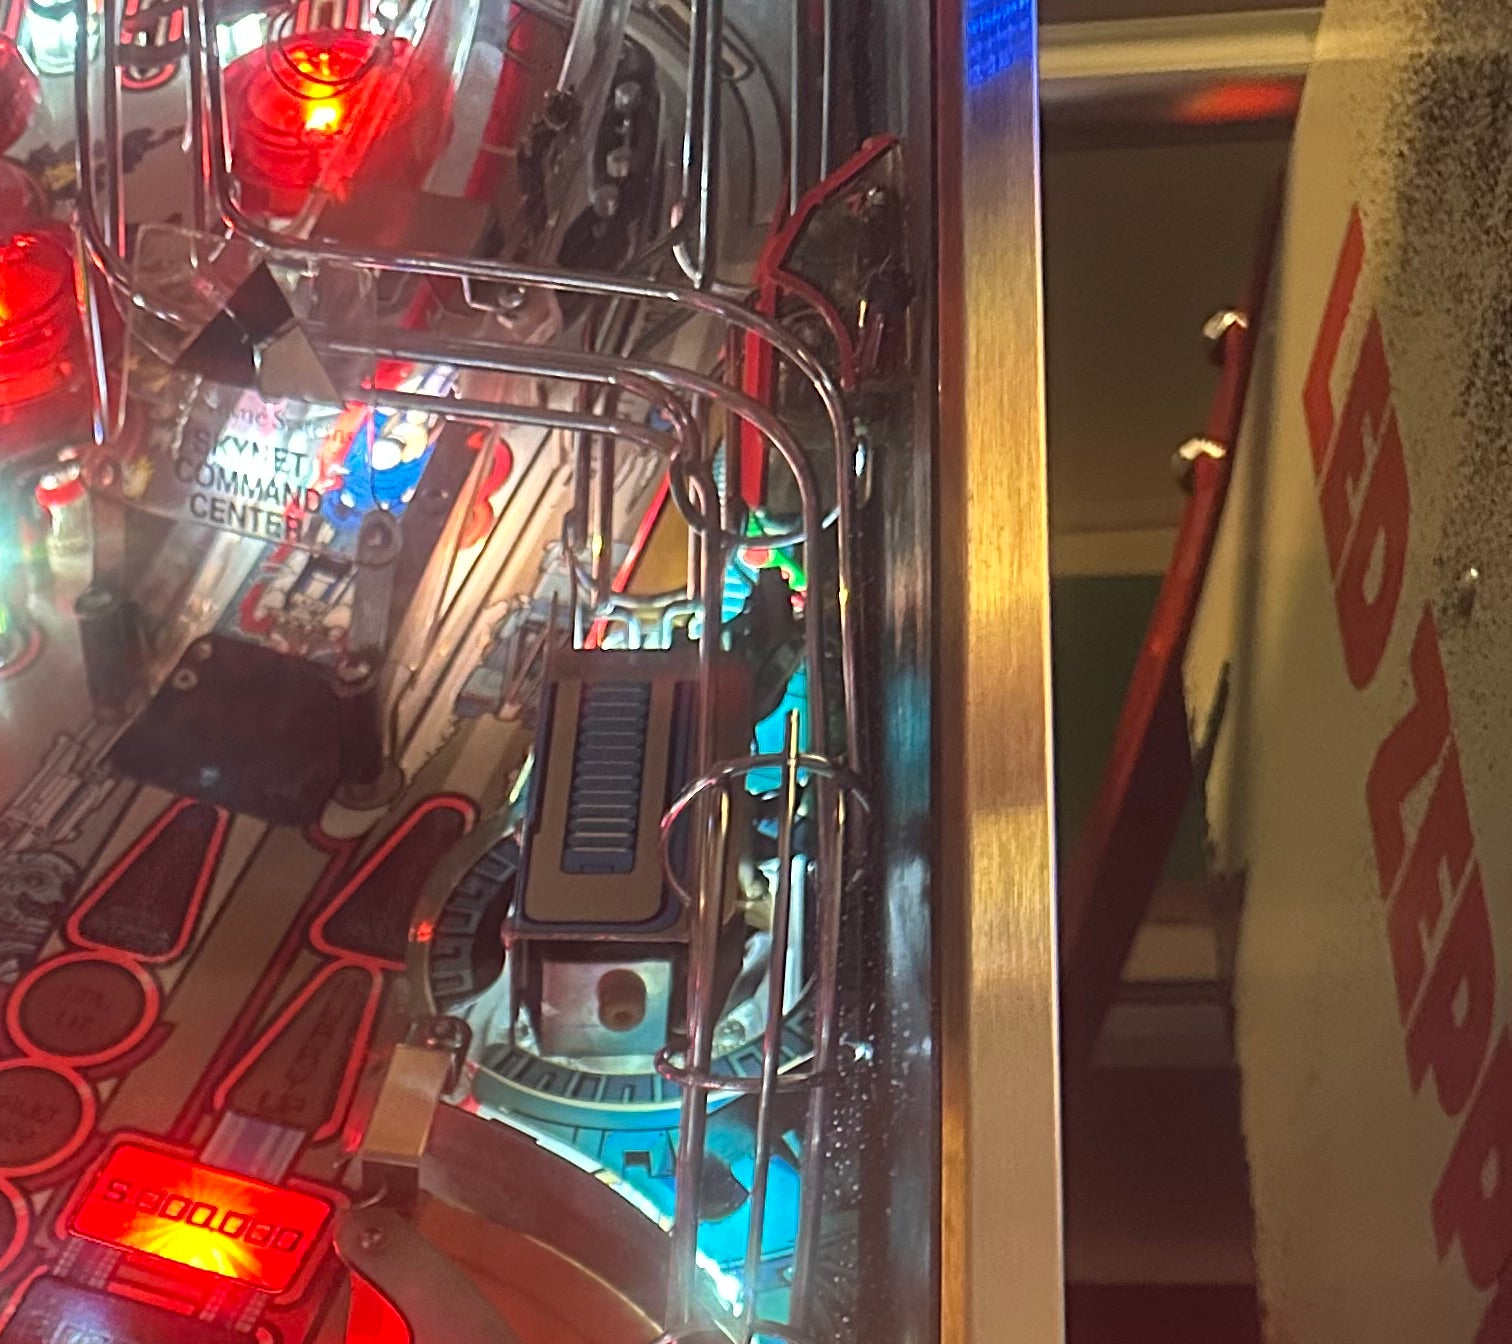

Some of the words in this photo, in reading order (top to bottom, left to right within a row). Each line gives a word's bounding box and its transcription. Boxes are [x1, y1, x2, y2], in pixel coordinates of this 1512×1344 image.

[195, 431, 309, 478] SKYNET
[175, 457, 322, 513] COMMAND
[190, 492, 302, 541] CENTER
